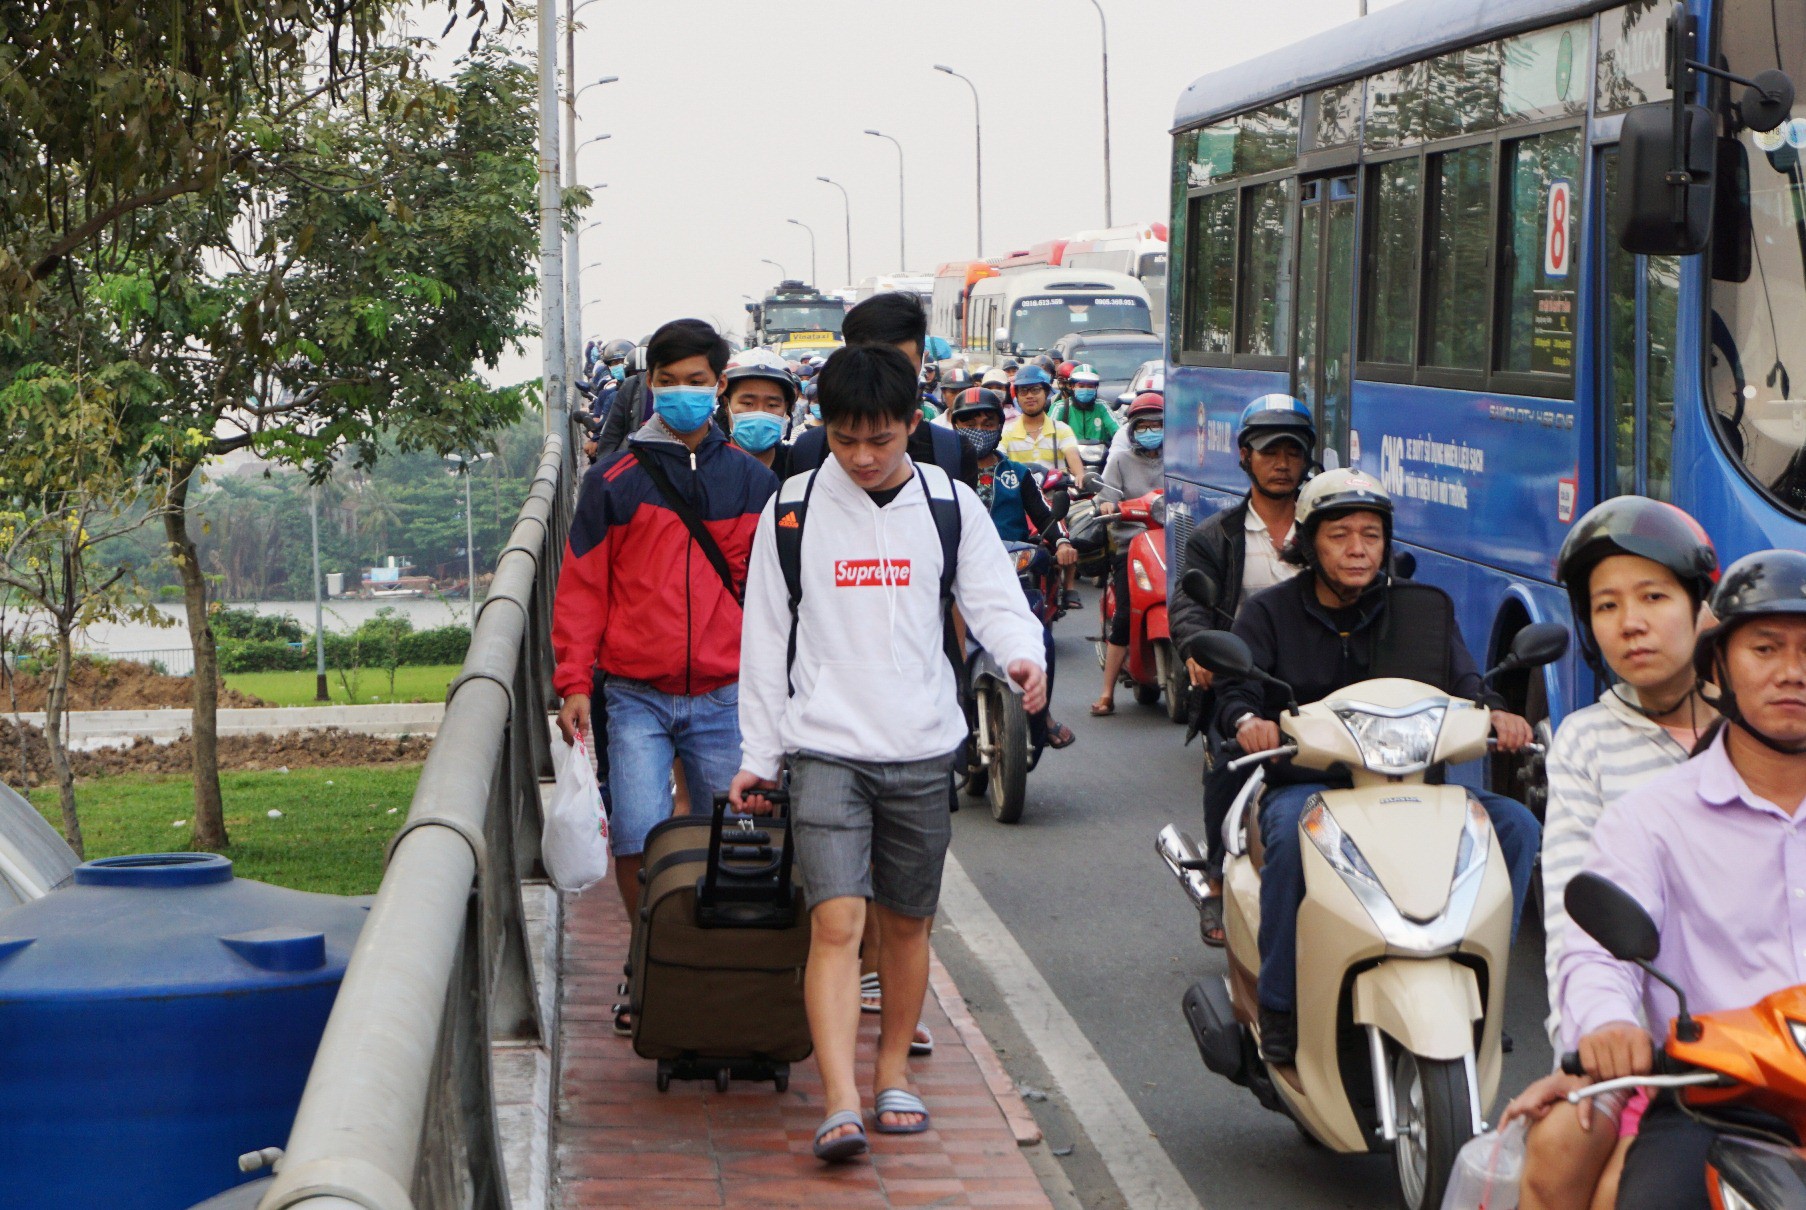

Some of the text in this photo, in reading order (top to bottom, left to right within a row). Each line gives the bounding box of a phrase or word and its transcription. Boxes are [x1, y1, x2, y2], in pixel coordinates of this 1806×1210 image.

[1613, 28, 1664, 76] SAMCO
[1551, 188, 1565, 269] 8
[1381, 434, 1404, 497] CNG
[836, 561, 911, 585] Supreme
